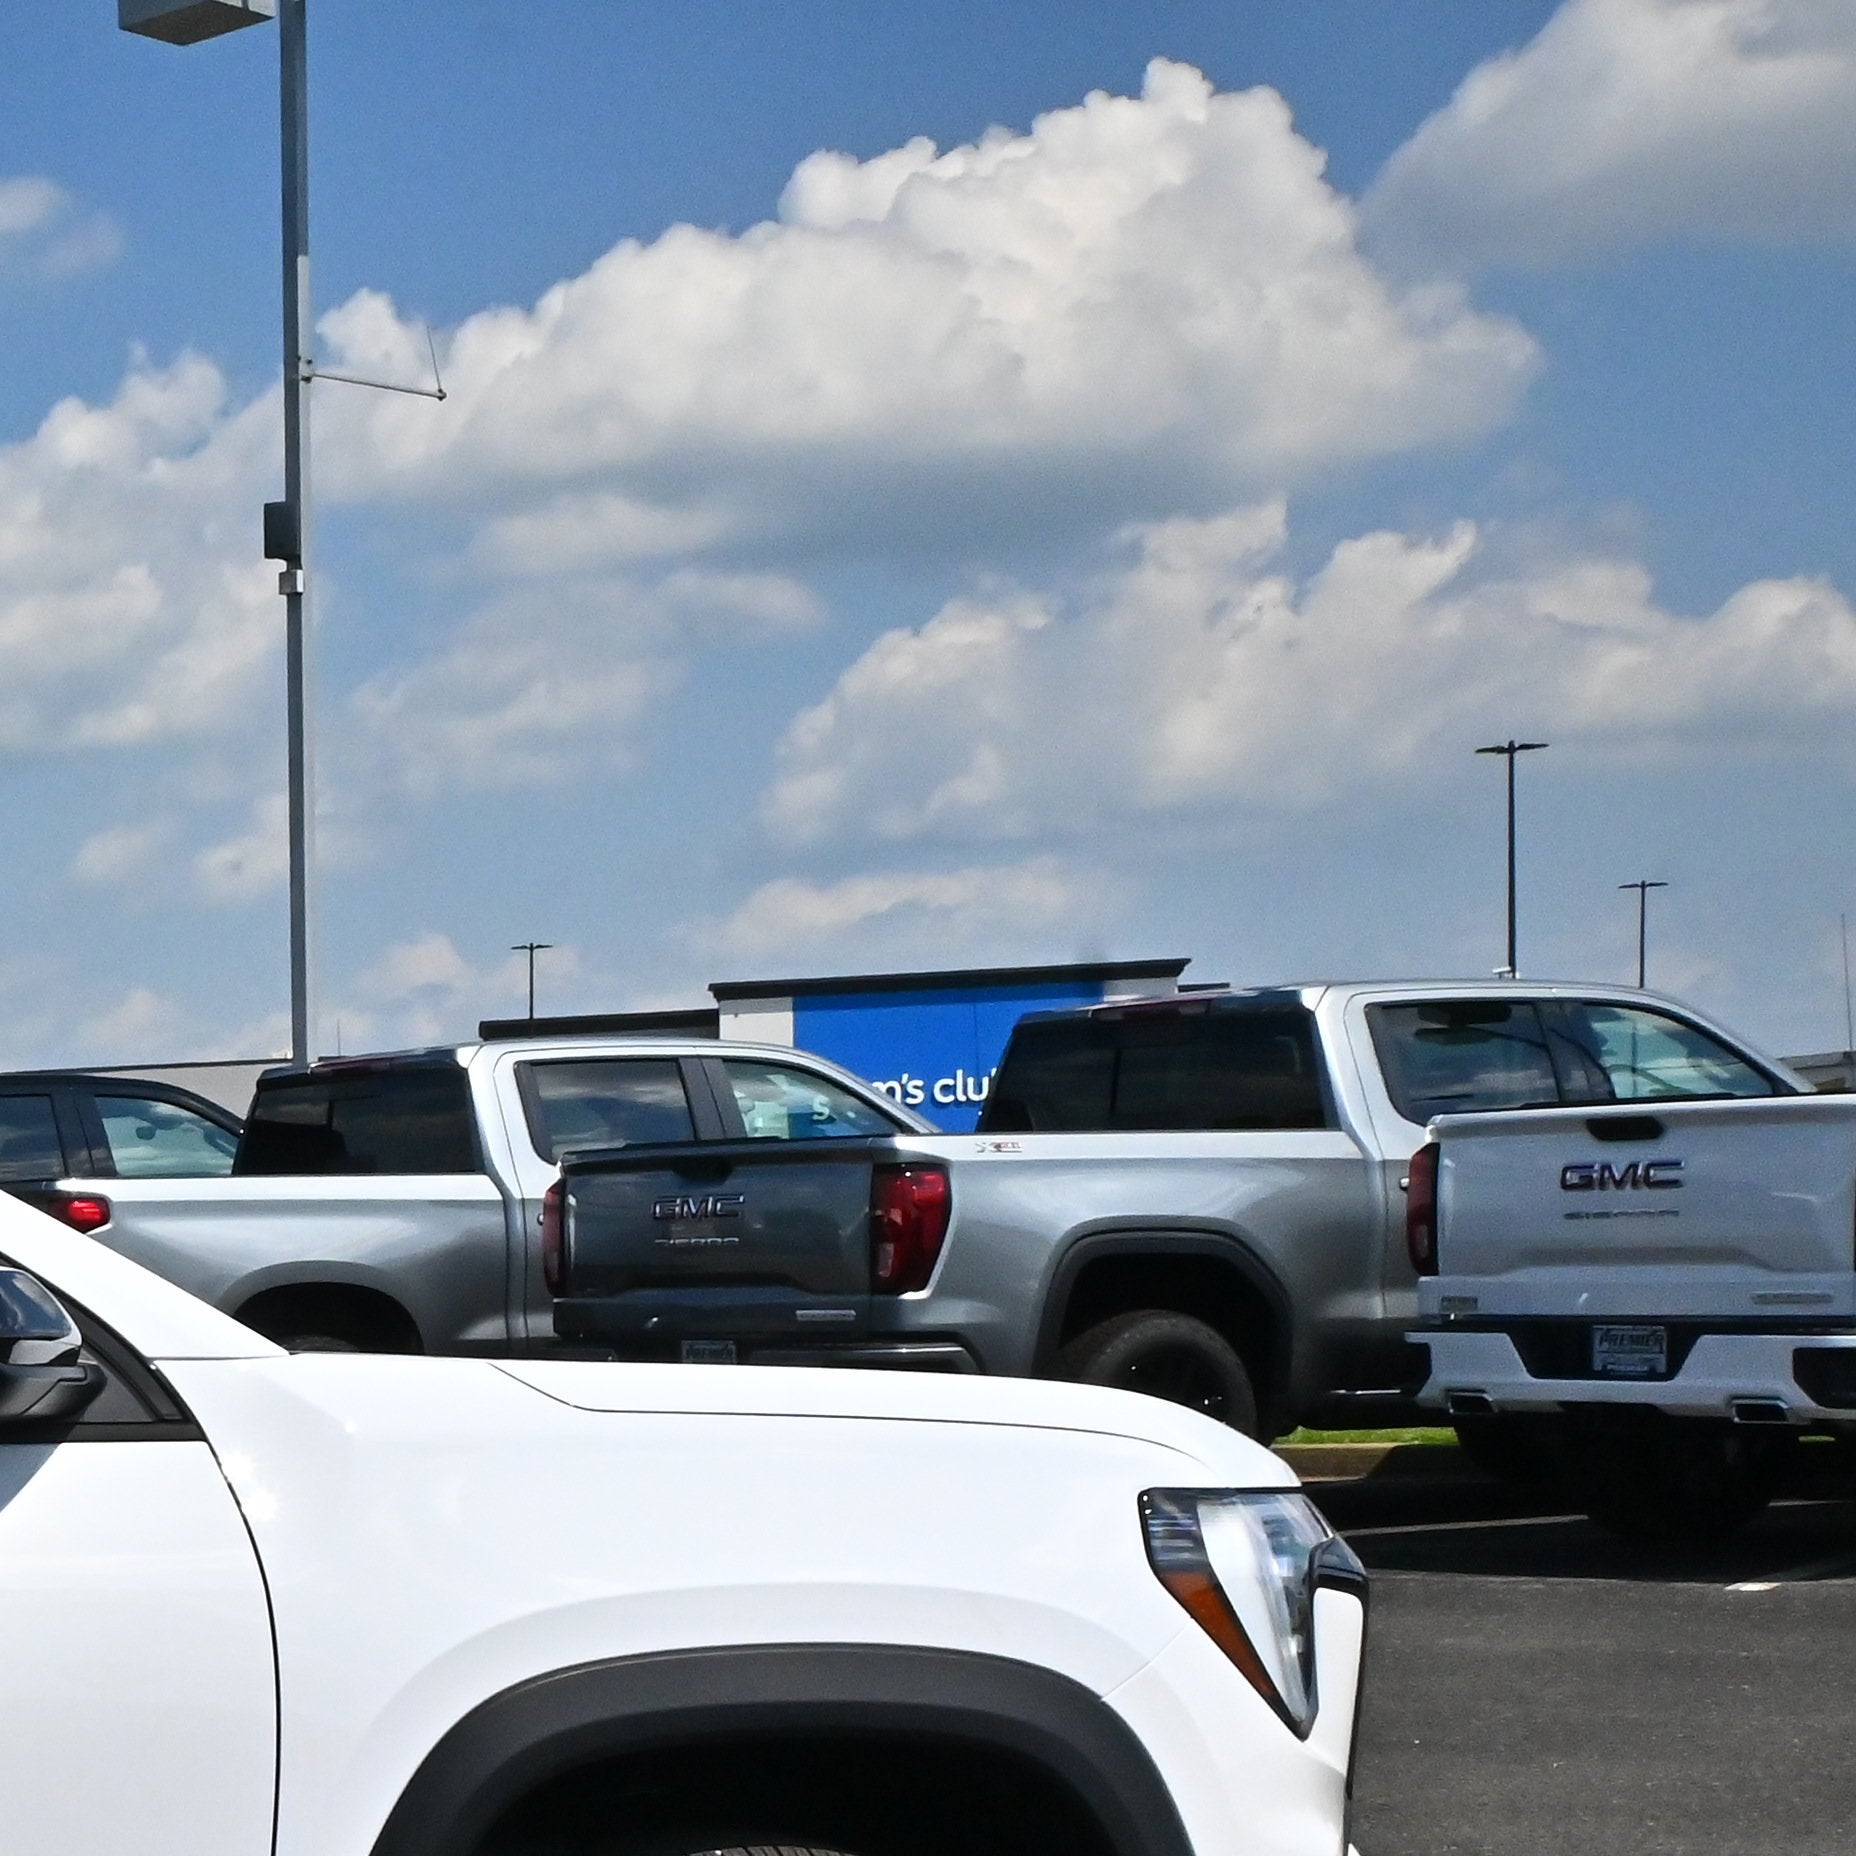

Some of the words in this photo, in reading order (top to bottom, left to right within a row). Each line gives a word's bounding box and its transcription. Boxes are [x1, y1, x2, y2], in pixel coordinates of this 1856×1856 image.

[934, 1068, 997, 1104] clu
[1561, 1159, 1685, 1191] GMC
[653, 1194, 745, 1219] GMC
